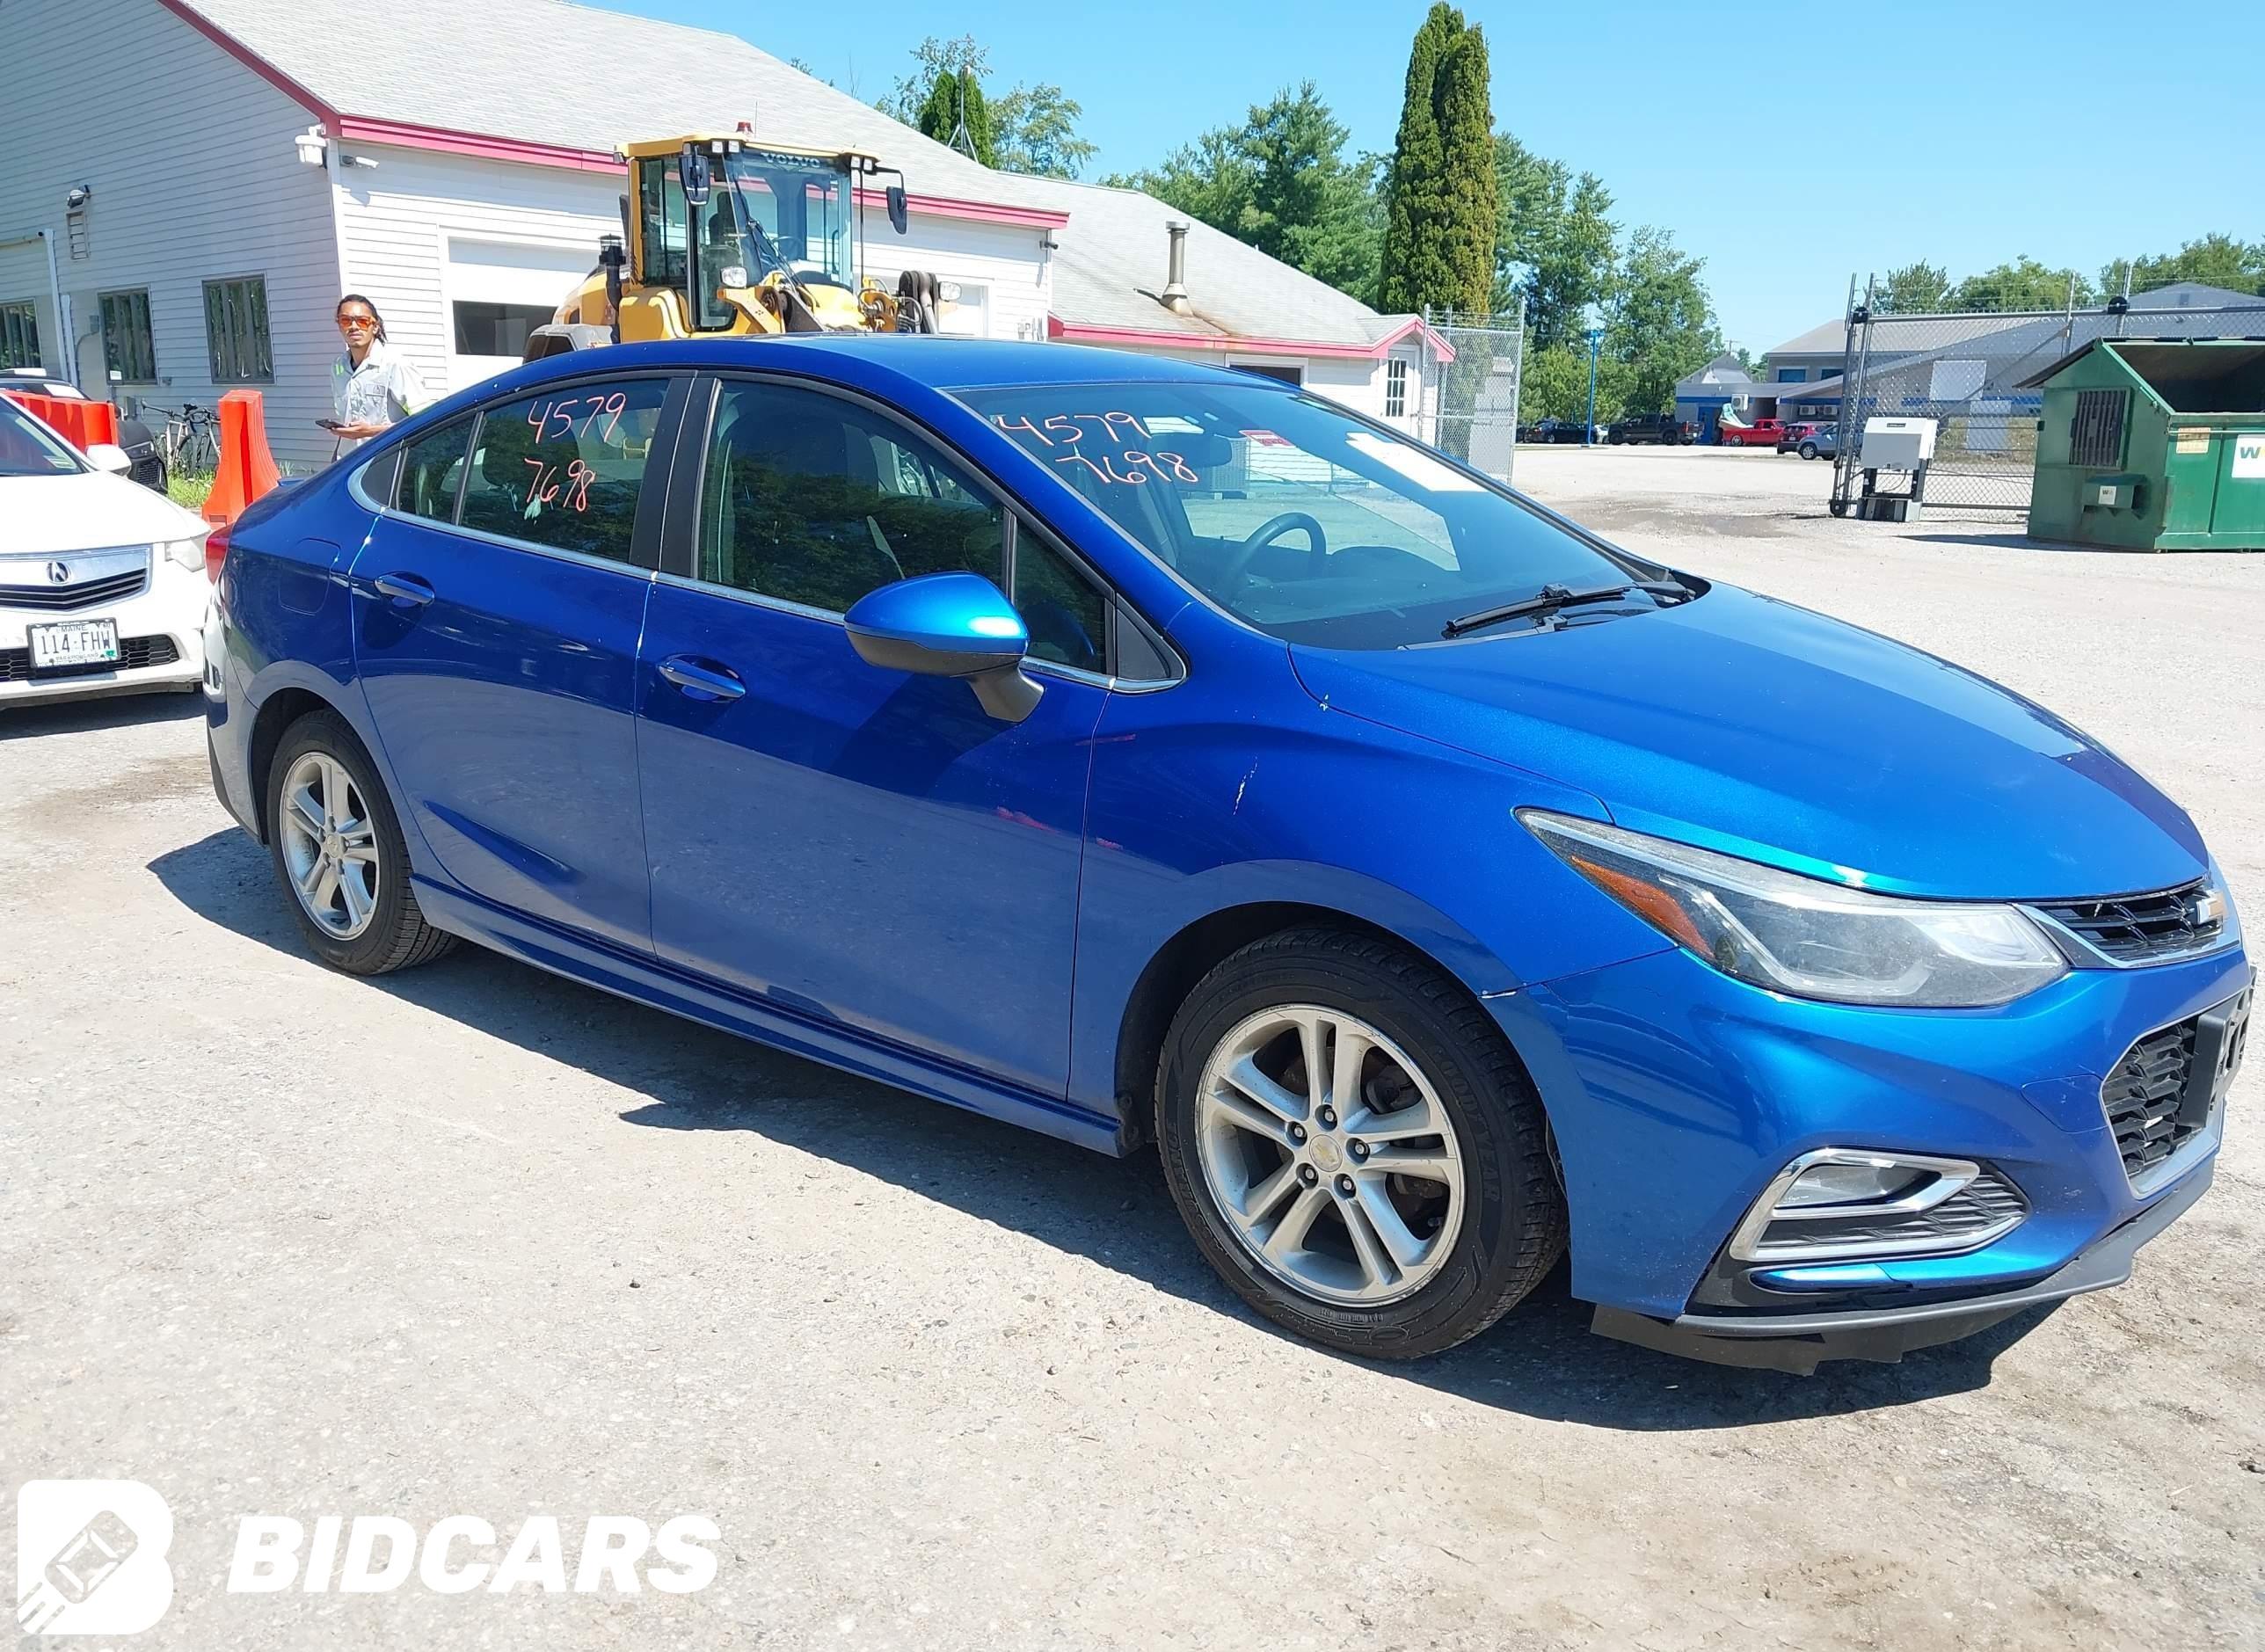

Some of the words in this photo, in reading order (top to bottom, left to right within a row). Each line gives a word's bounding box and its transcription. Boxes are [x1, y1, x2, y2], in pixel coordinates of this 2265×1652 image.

[761, 152, 820, 168] VOLVO
[528, 392, 626, 444] 4579
[996, 411, 1153, 447] 4579
[1055, 451, 1198, 484] 7698
[524, 458, 596, 512] 7698
[62, 624, 87, 633] MAINE
